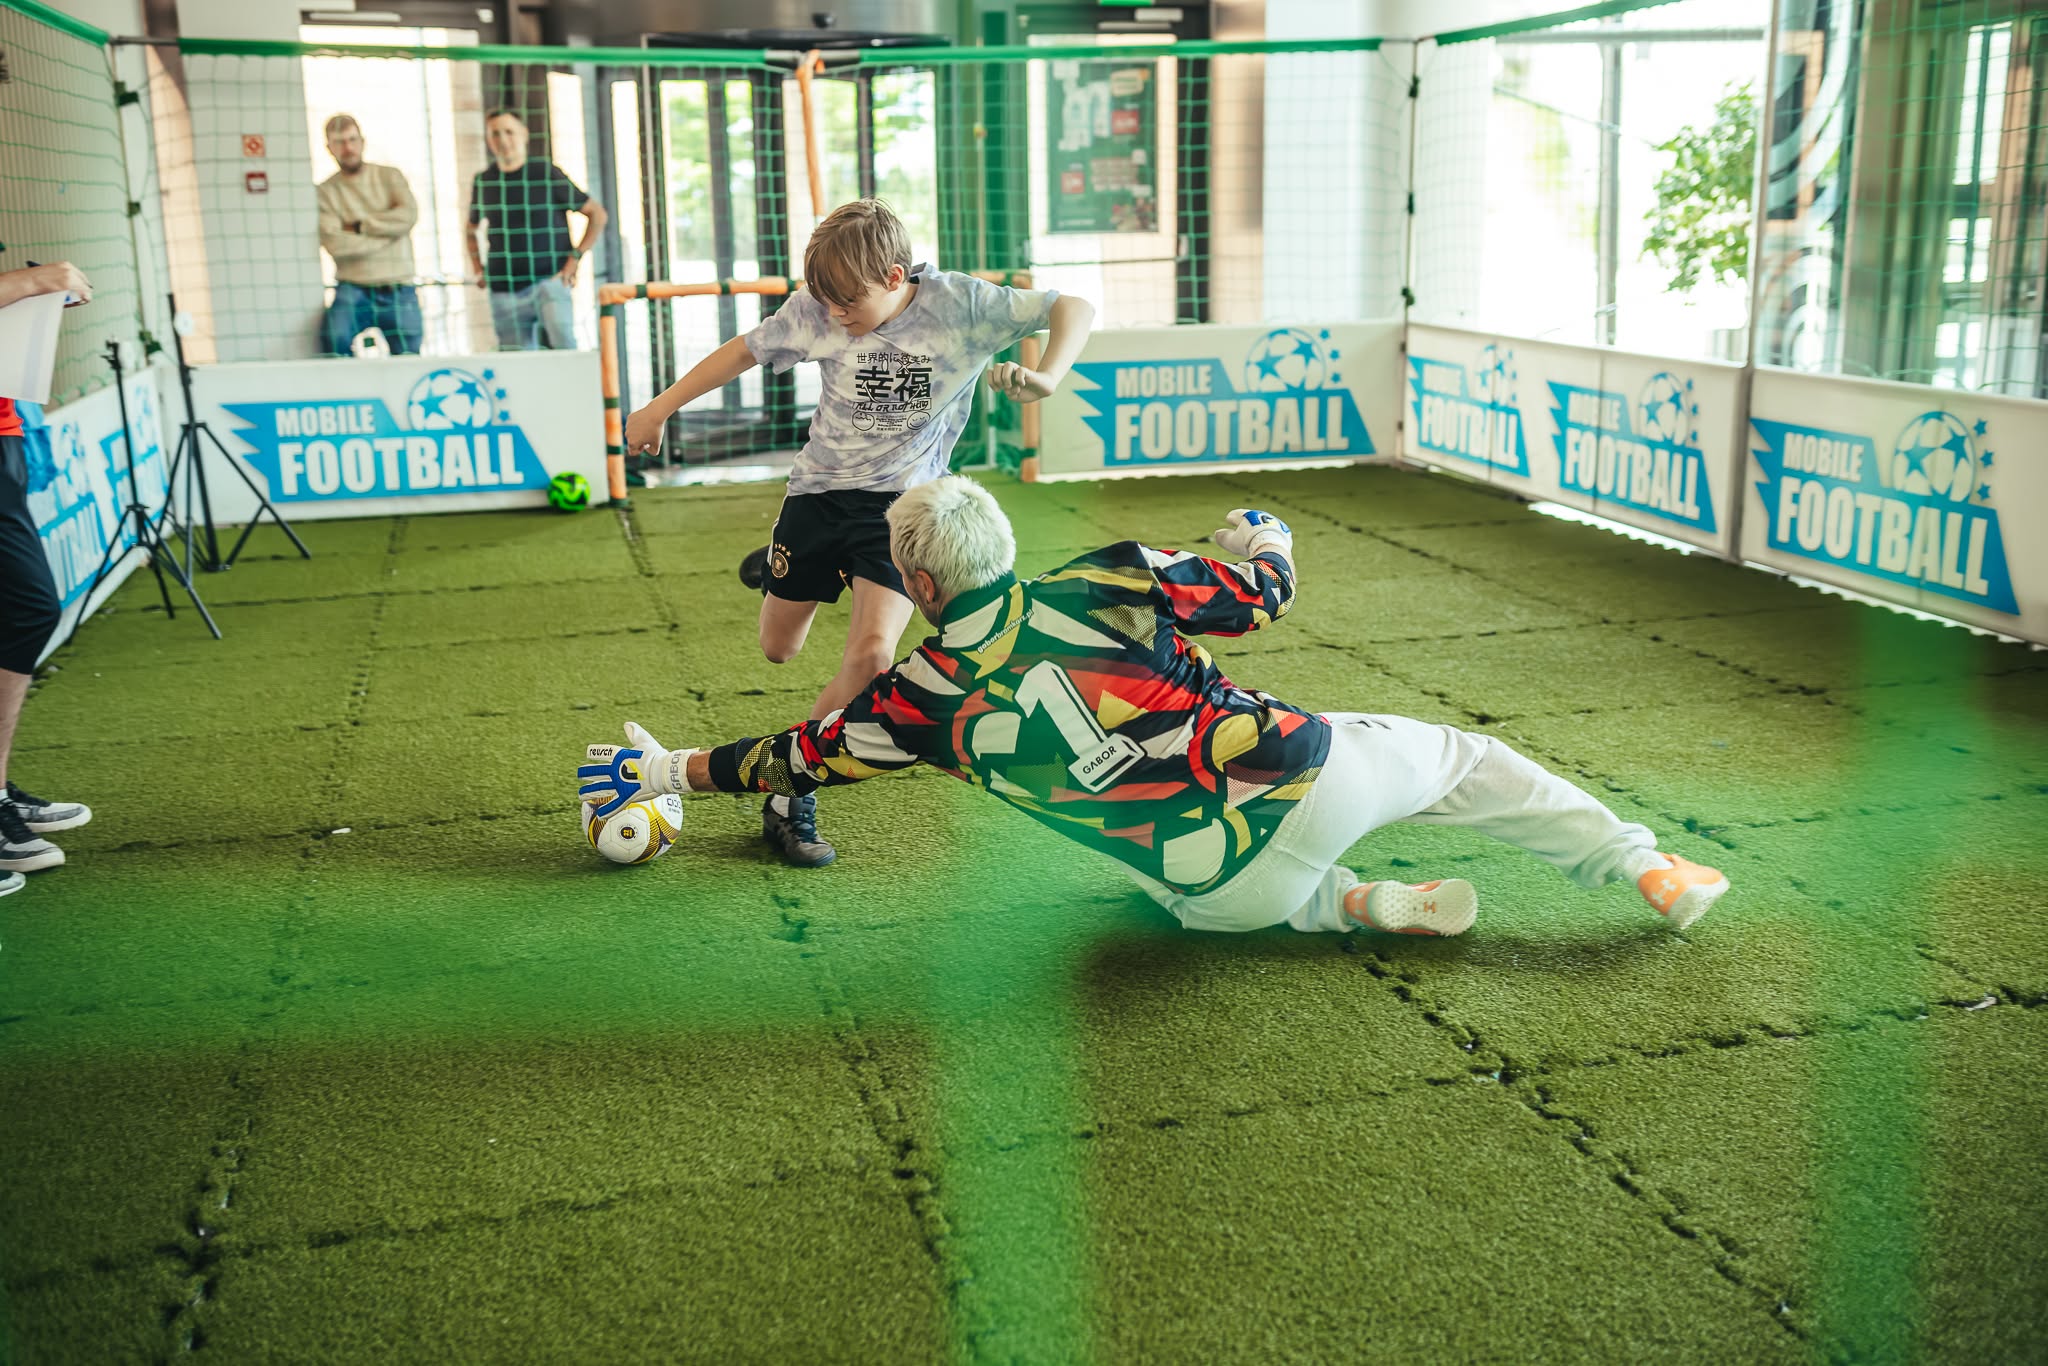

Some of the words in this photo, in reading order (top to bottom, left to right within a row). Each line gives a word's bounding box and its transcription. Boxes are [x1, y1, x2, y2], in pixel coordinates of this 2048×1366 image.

[1116, 365, 1211, 398] MOBILE
[275, 404, 376, 437] MOBILE
[1115, 396, 1348, 460] FOOTBALL
[278, 433, 524, 495] FOOTBALL
[1565, 427, 1700, 520] FOOTBALL
[1783, 432, 1864, 482] MOBILE
[1777, 476, 1988, 595] FOOTBALL
[589, 748, 613, 756] reusch
[1083, 746, 1117, 774] GABOR
